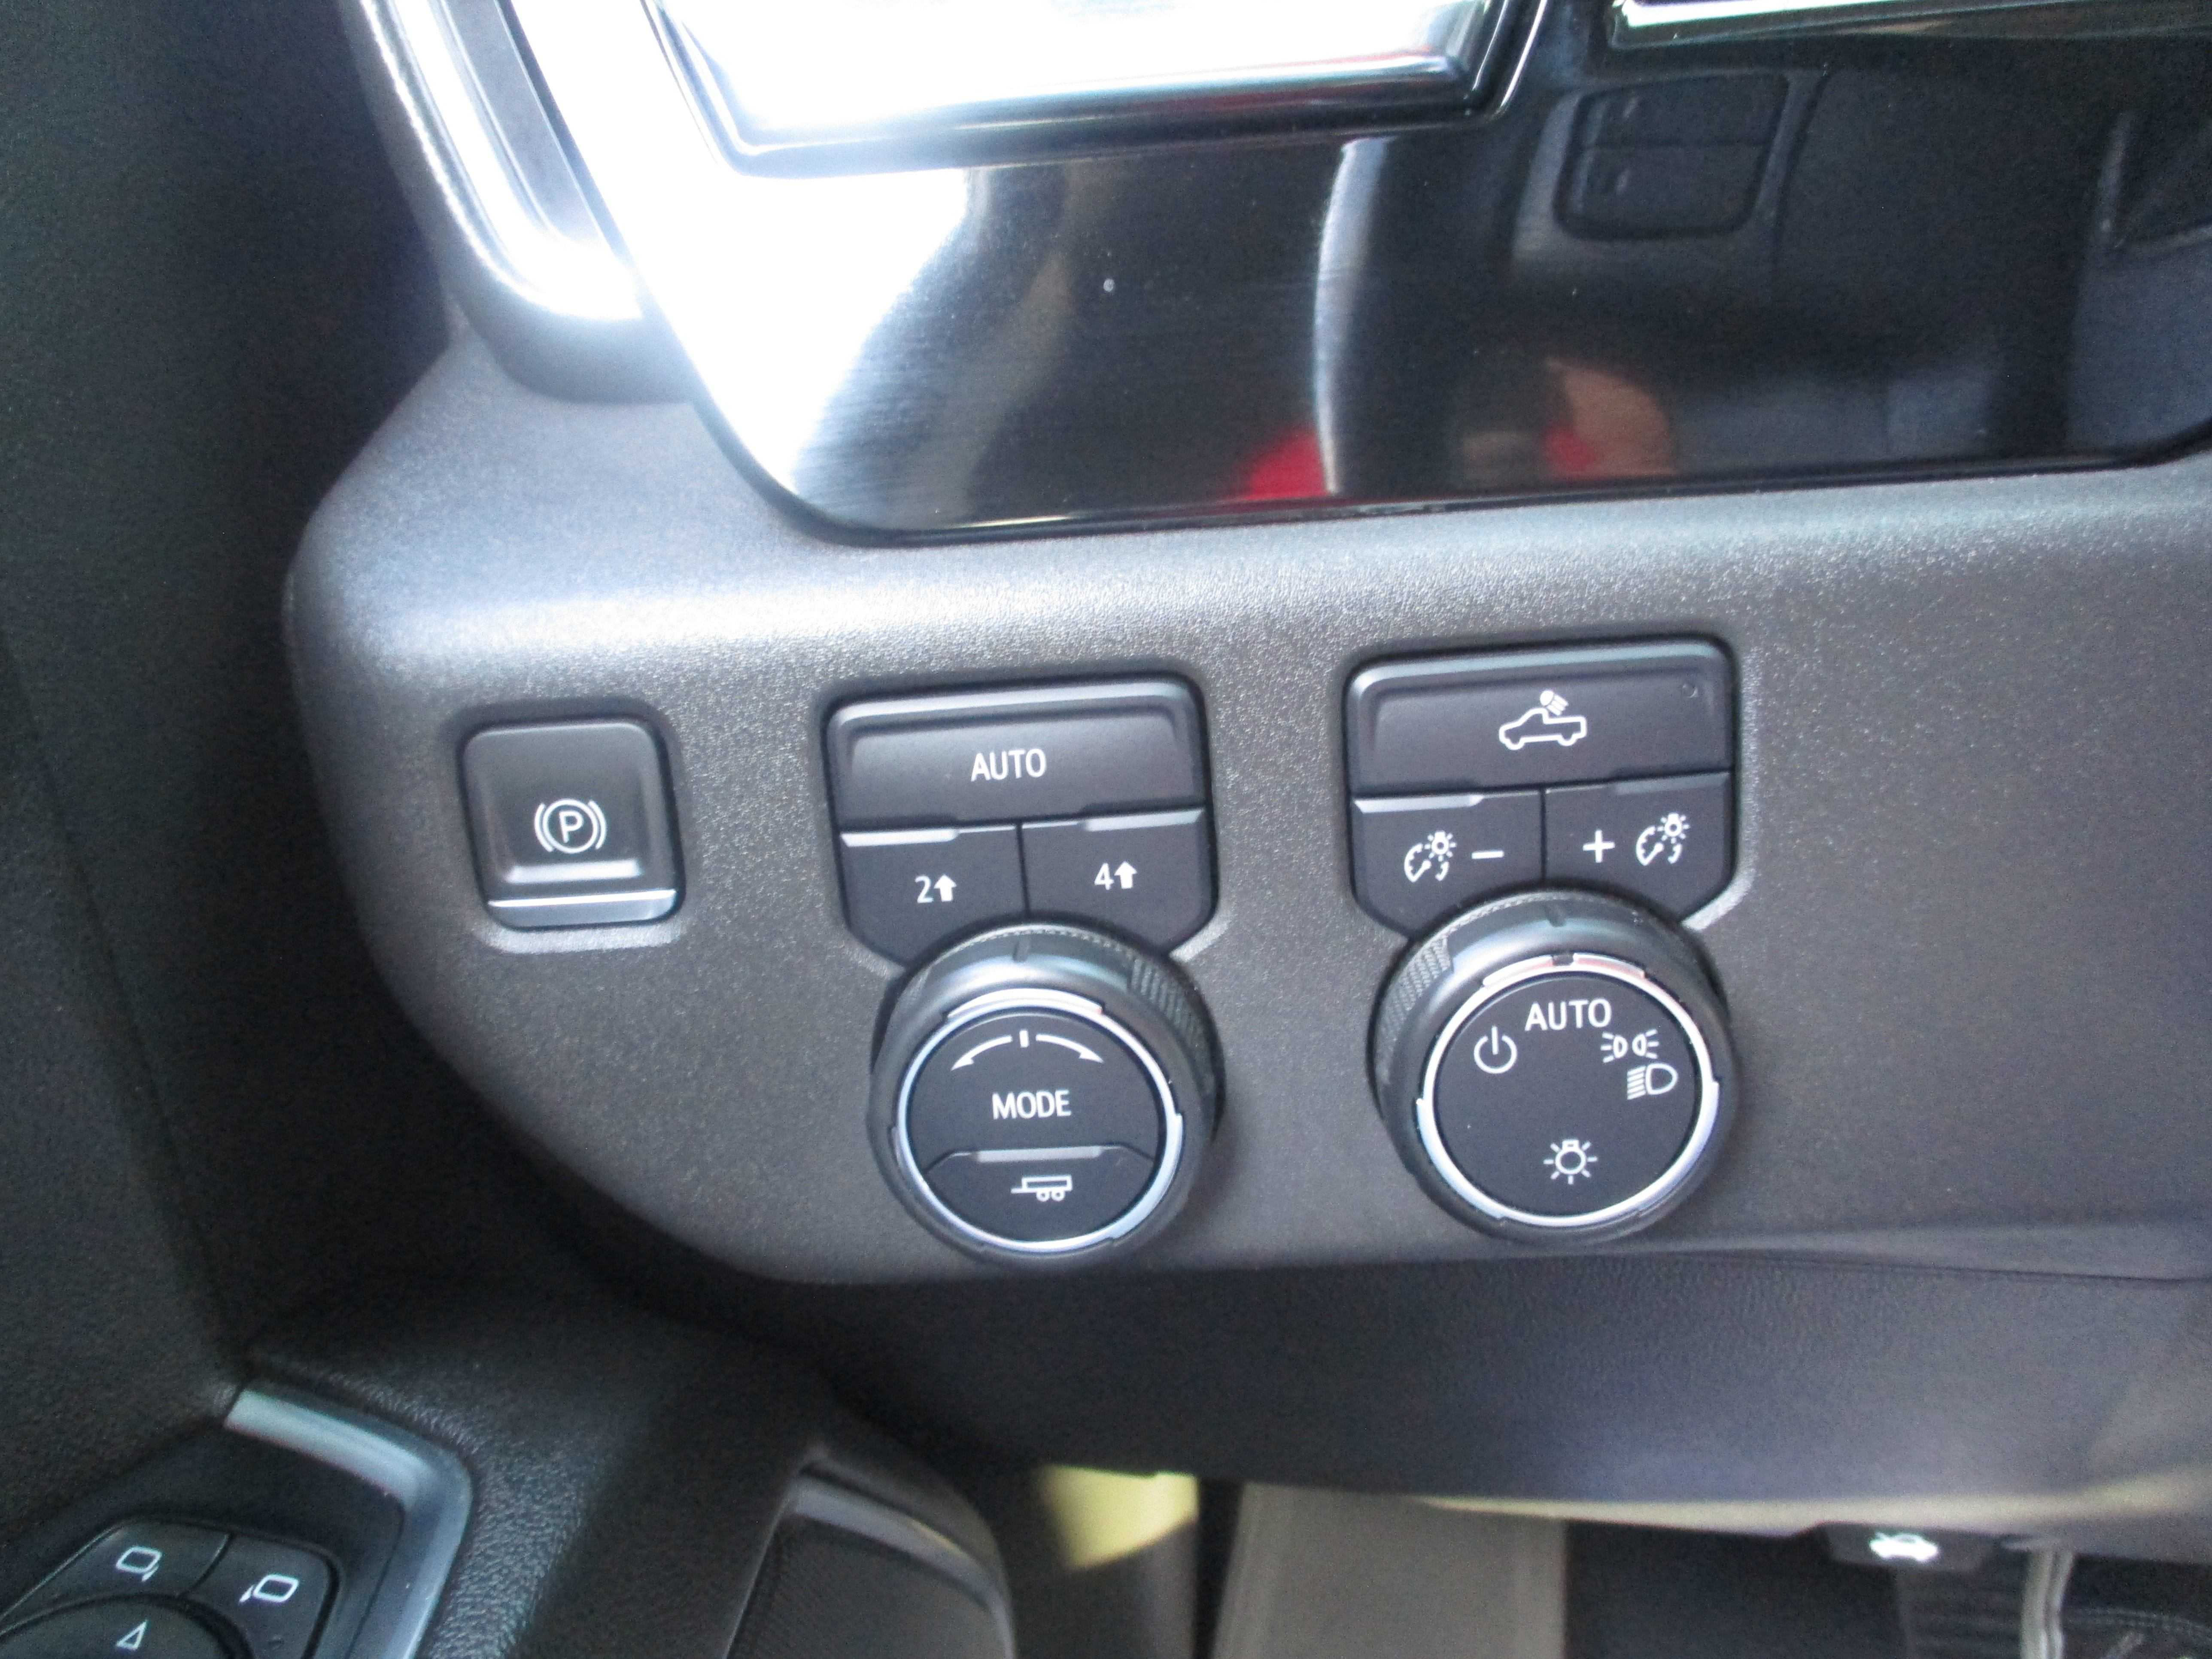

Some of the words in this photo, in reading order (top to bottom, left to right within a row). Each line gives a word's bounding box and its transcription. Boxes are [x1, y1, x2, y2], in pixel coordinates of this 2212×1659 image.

[970, 748, 1047, 782] AUTO
[558, 810, 583, 843] P
[915, 875, 934, 903] 2
[1094, 862, 1115, 890] 4
[1524, 997, 1612, 1031] AUTO
[992, 1088, 1072, 1120] MODE
